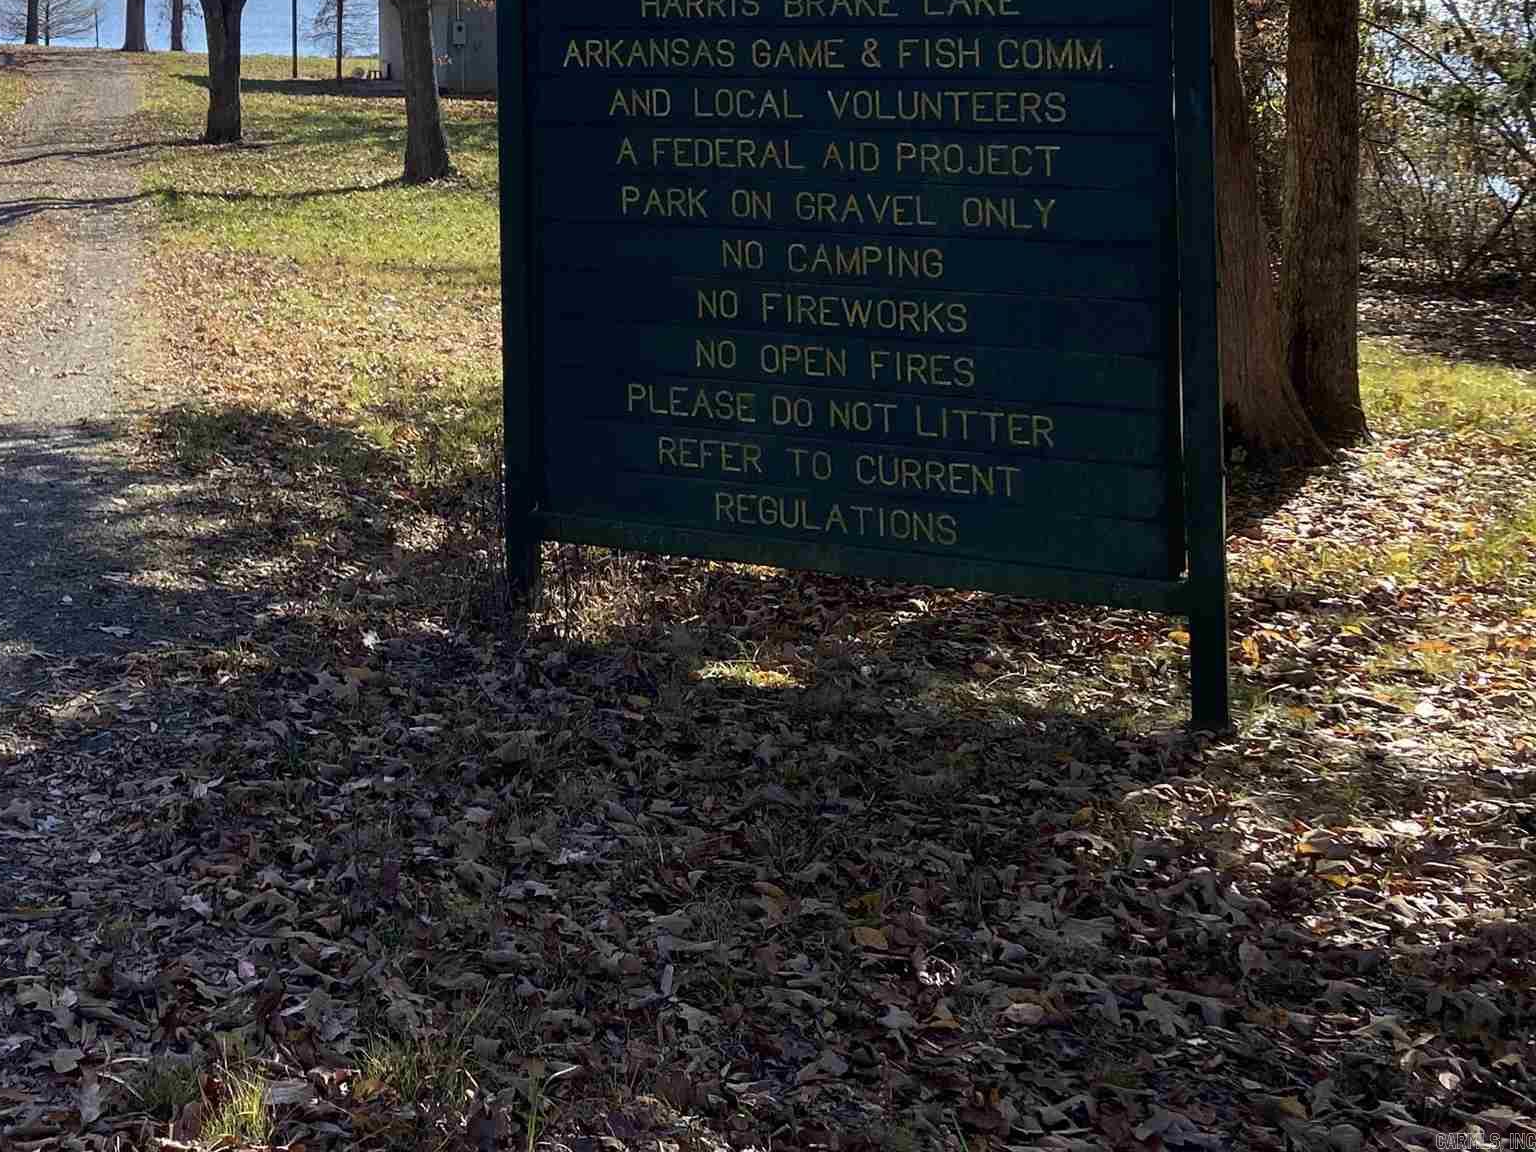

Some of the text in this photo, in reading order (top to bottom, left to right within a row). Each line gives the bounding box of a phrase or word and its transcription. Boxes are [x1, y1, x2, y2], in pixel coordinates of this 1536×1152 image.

[564, 40, 1114, 71] ARKANSAS GAME & FISH COMM.
[610, 89, 1066, 122] AND LOCAL VOLUNTEERS
[616, 138, 1060, 176] A FEDERAL AID PROJECT
[622, 186, 1055, 229] PARK ON GRAVEL ONLY
[722, 239, 943, 278] NO CAMPING
[698, 290, 966, 332] NO FIREWORKS
[696, 340, 974, 386] NO OPEN FIRES
[628, 384, 1054, 447] PLEASE DO NOT LITTER
[659, 437, 1020, 496] REFER TO CURRENT
[715, 492, 959, 545] REGULATIONS
